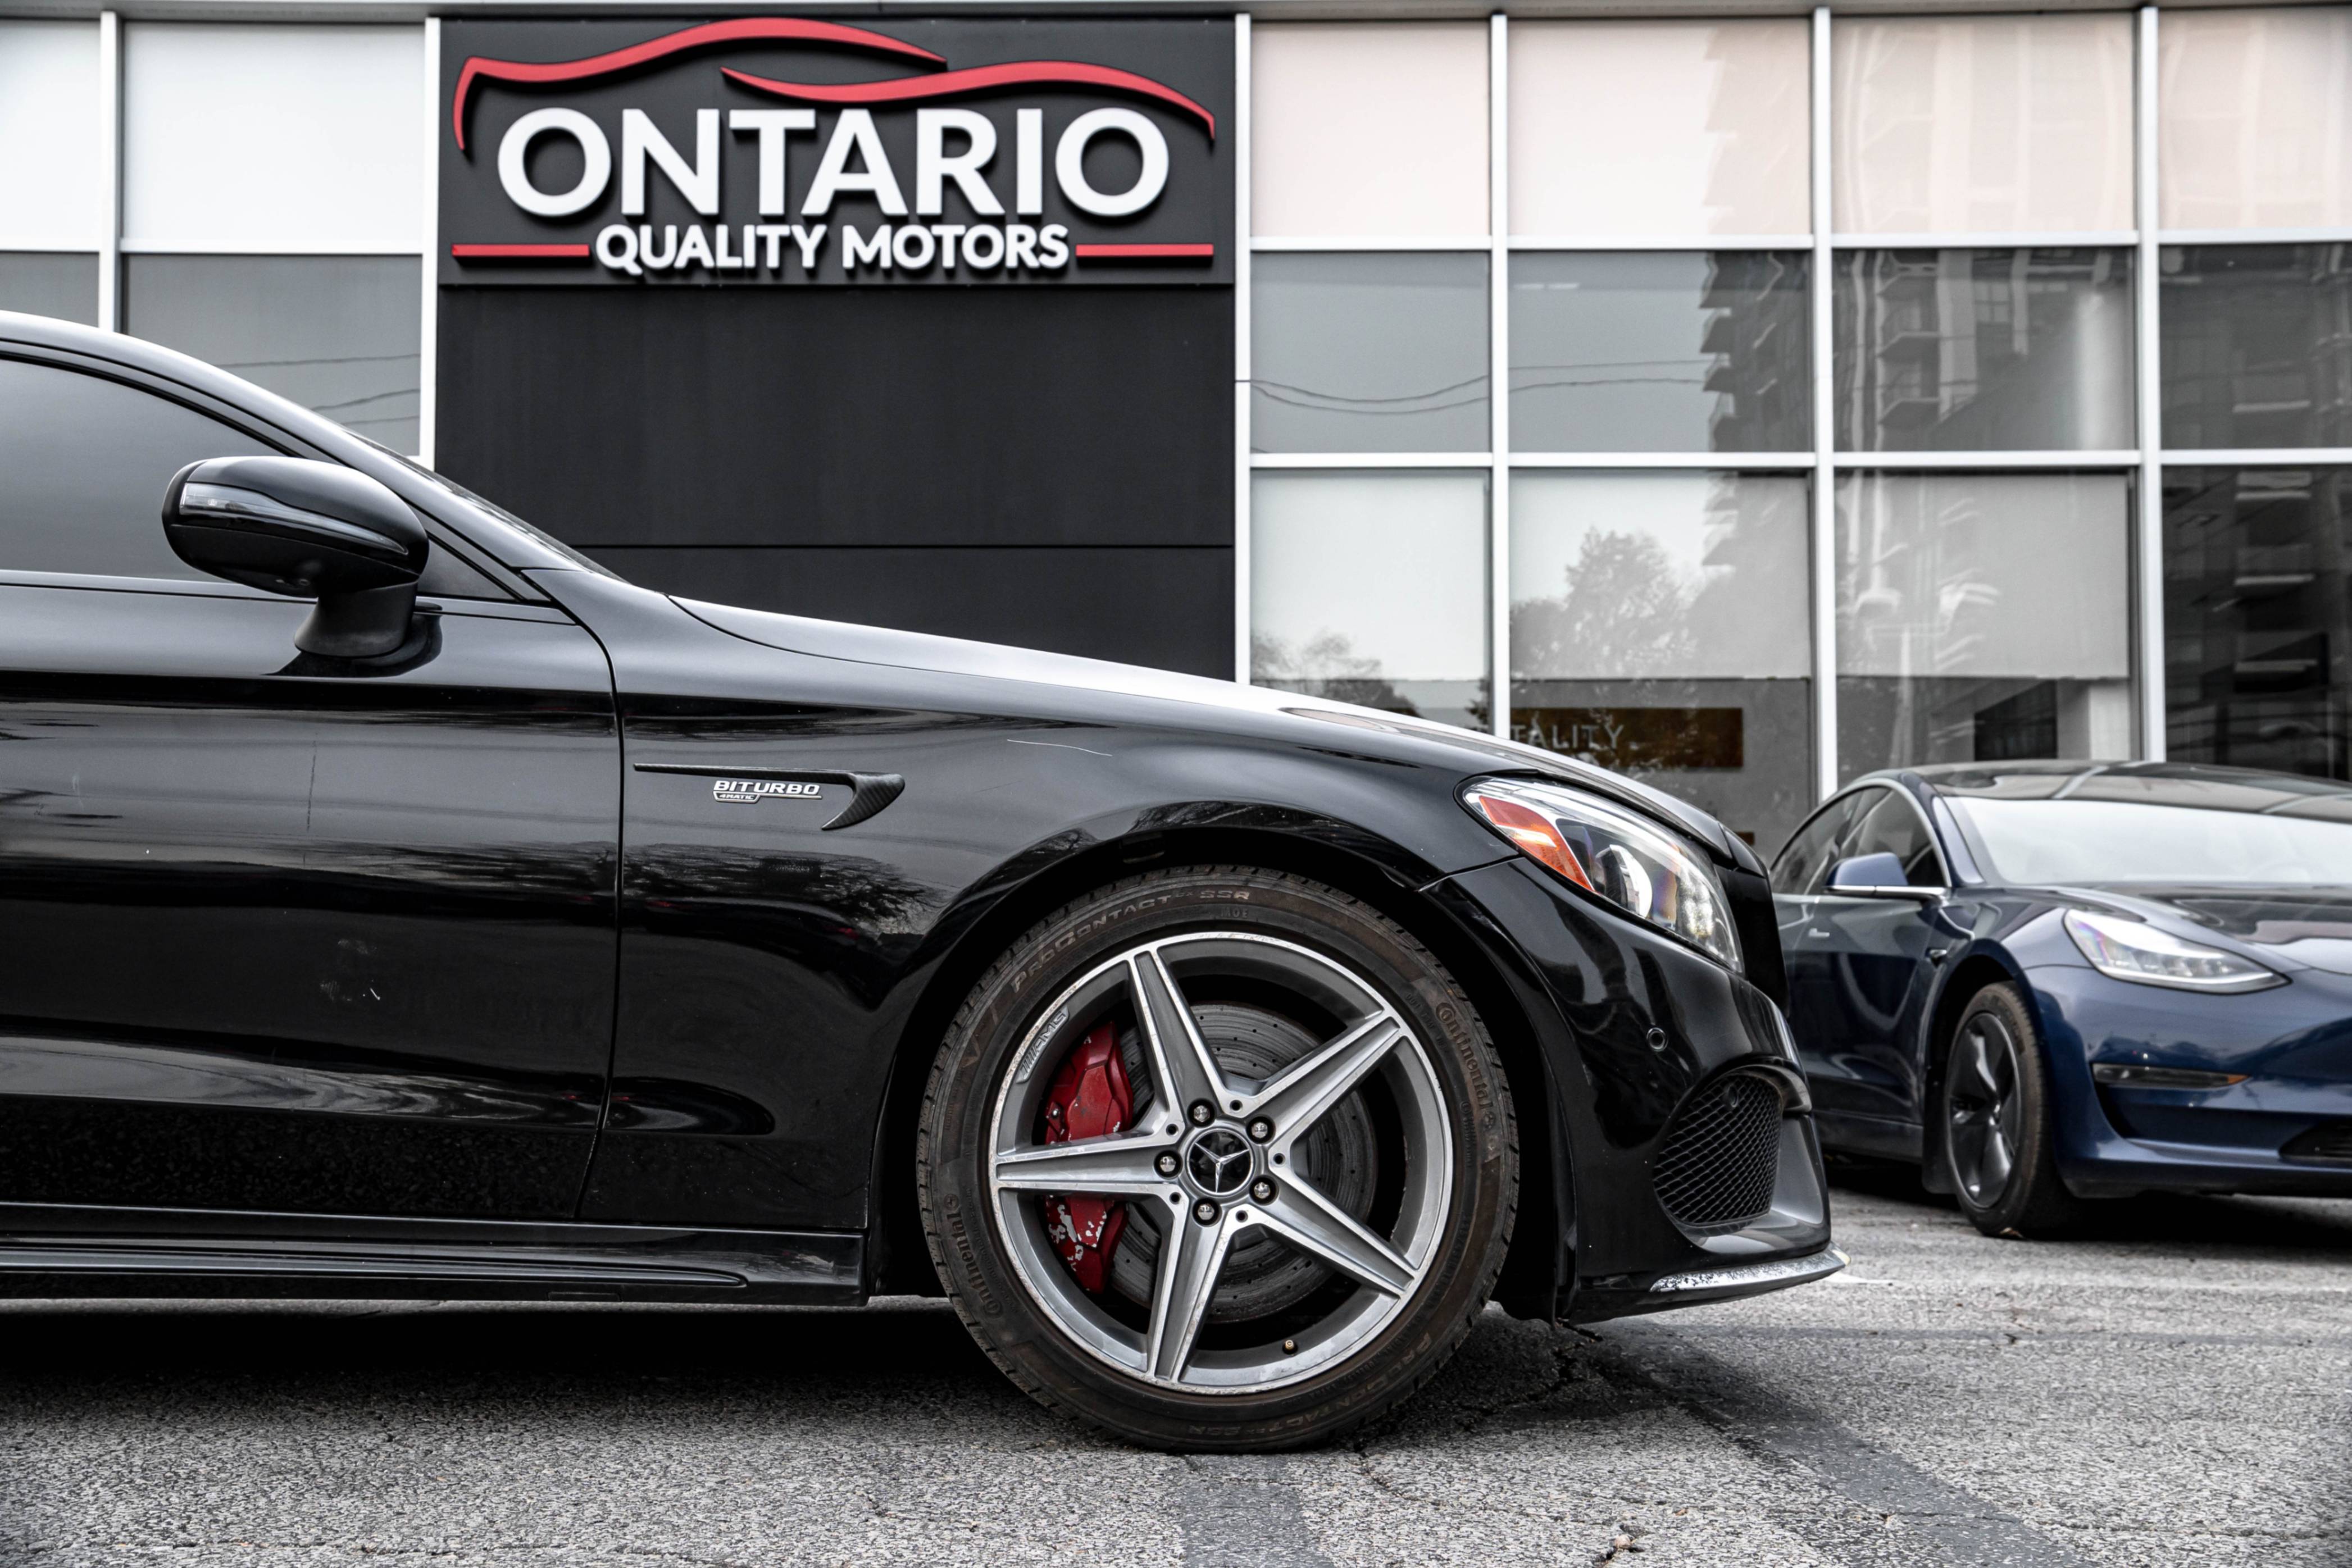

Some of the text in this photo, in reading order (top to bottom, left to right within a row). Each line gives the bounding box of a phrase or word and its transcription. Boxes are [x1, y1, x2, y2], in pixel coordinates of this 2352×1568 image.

[498, 108, 1168, 215] ONTARIO
[596, 224, 1068, 274] QUALITY MOTORS
[713, 780, 820, 795] BITURBO
[1199, 890, 1250, 900] SSR
[1030, 1011, 1066, 1057] AMG
[1435, 1002, 1494, 1110] Continental
[947, 1211, 1003, 1319] Continental
